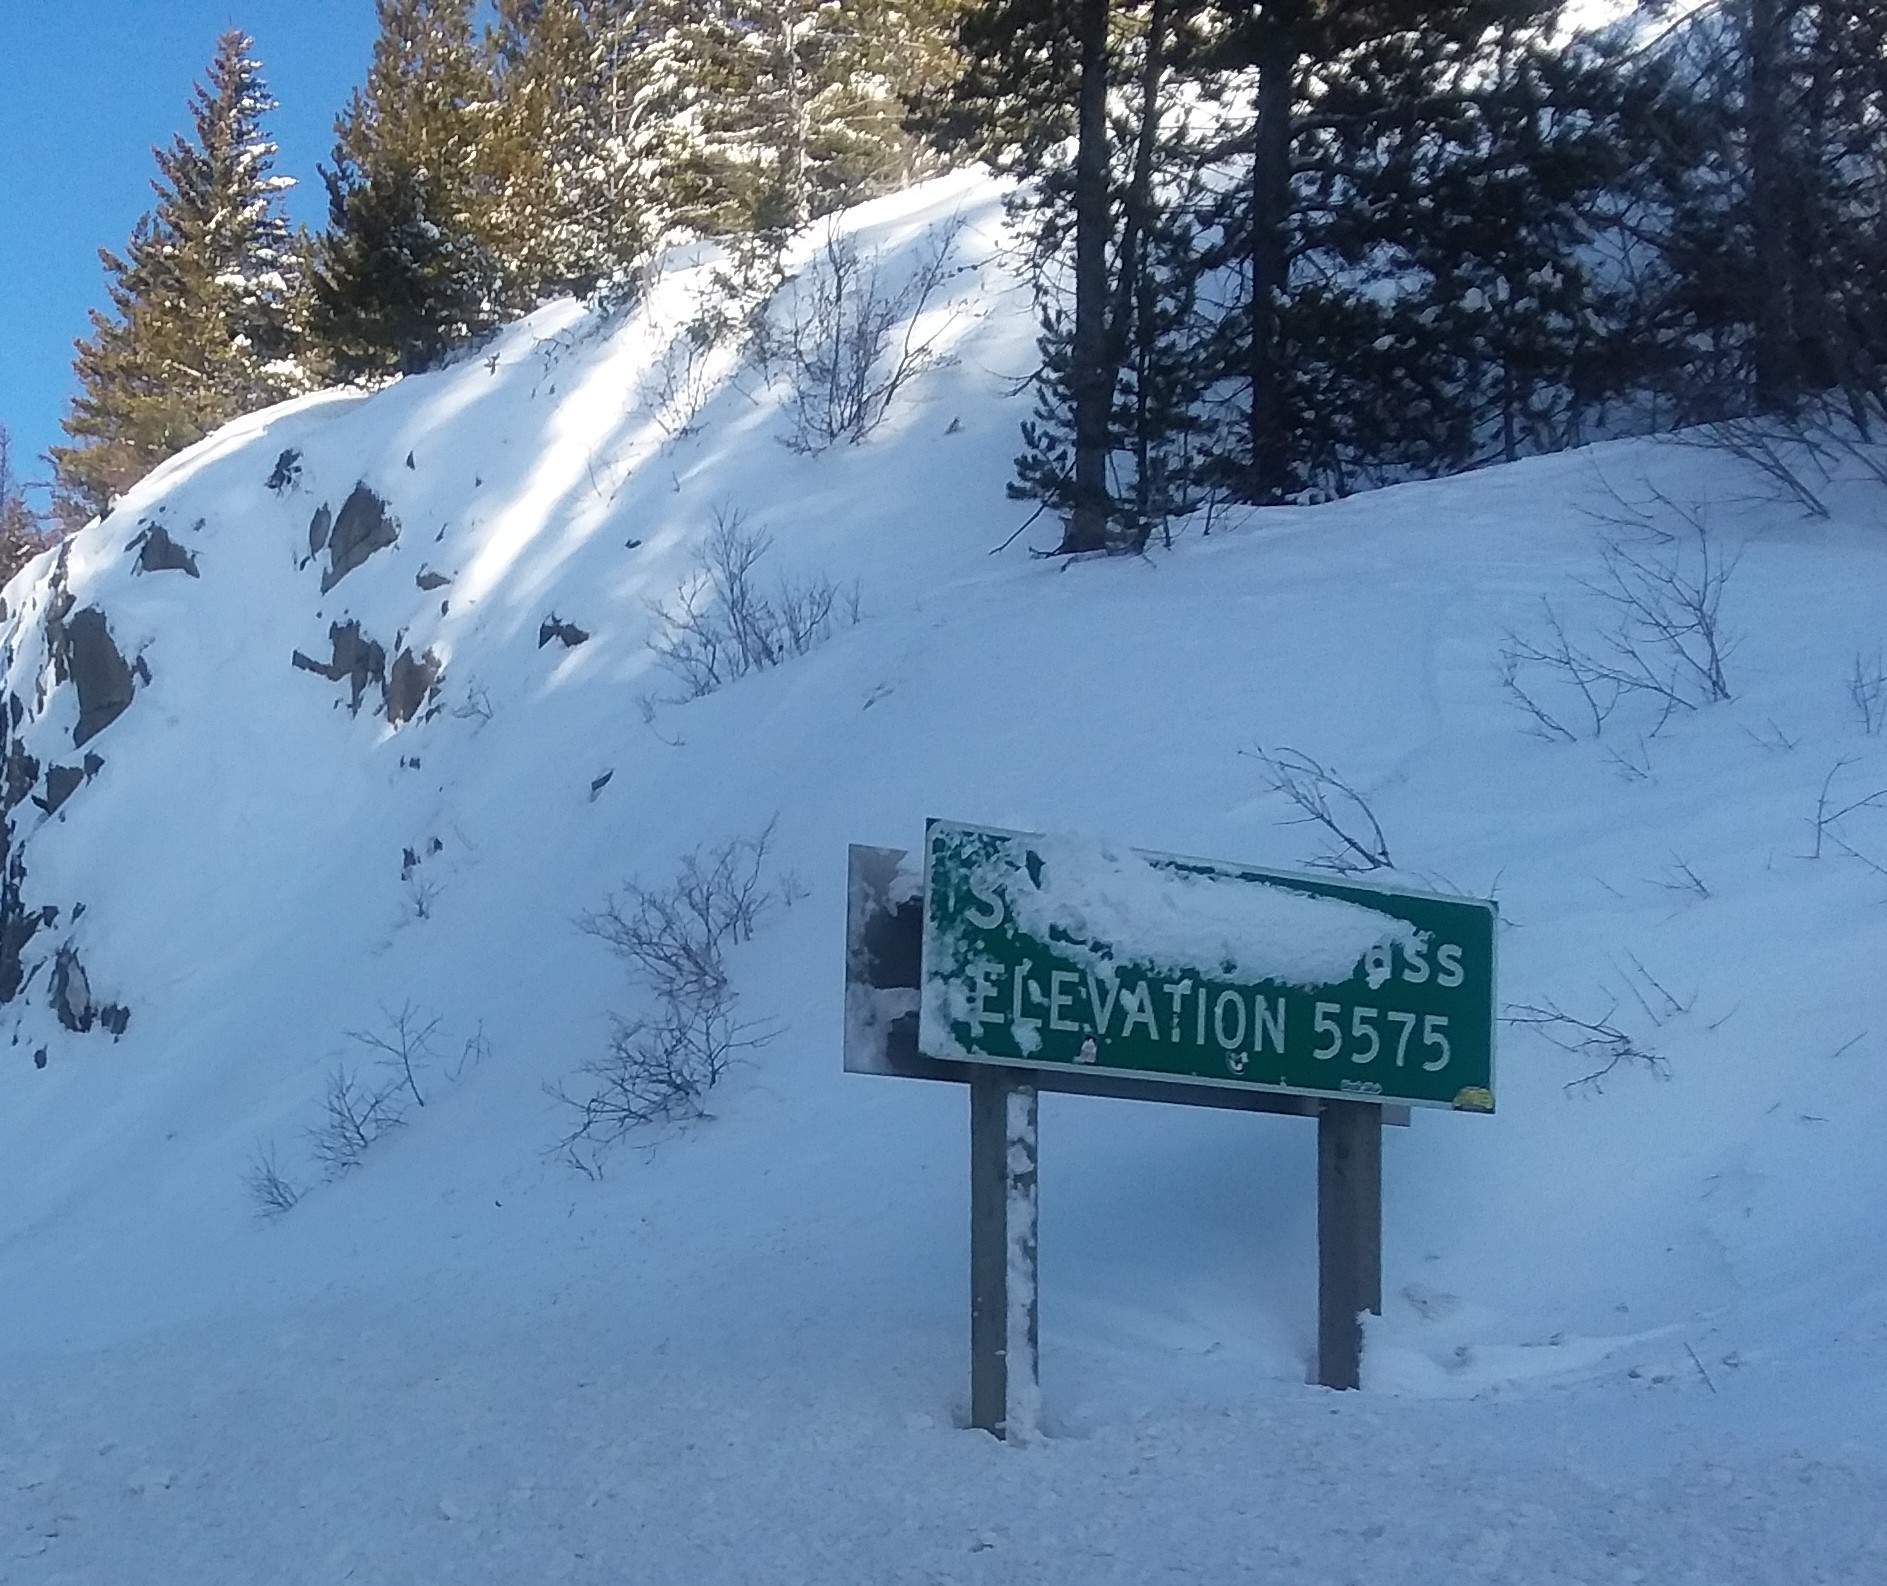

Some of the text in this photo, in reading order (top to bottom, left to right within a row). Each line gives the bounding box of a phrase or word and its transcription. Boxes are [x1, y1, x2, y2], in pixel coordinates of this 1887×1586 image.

[1362, 932, 1464, 988] ass
[973, 961, 1451, 1072] ELEVATION 5575
